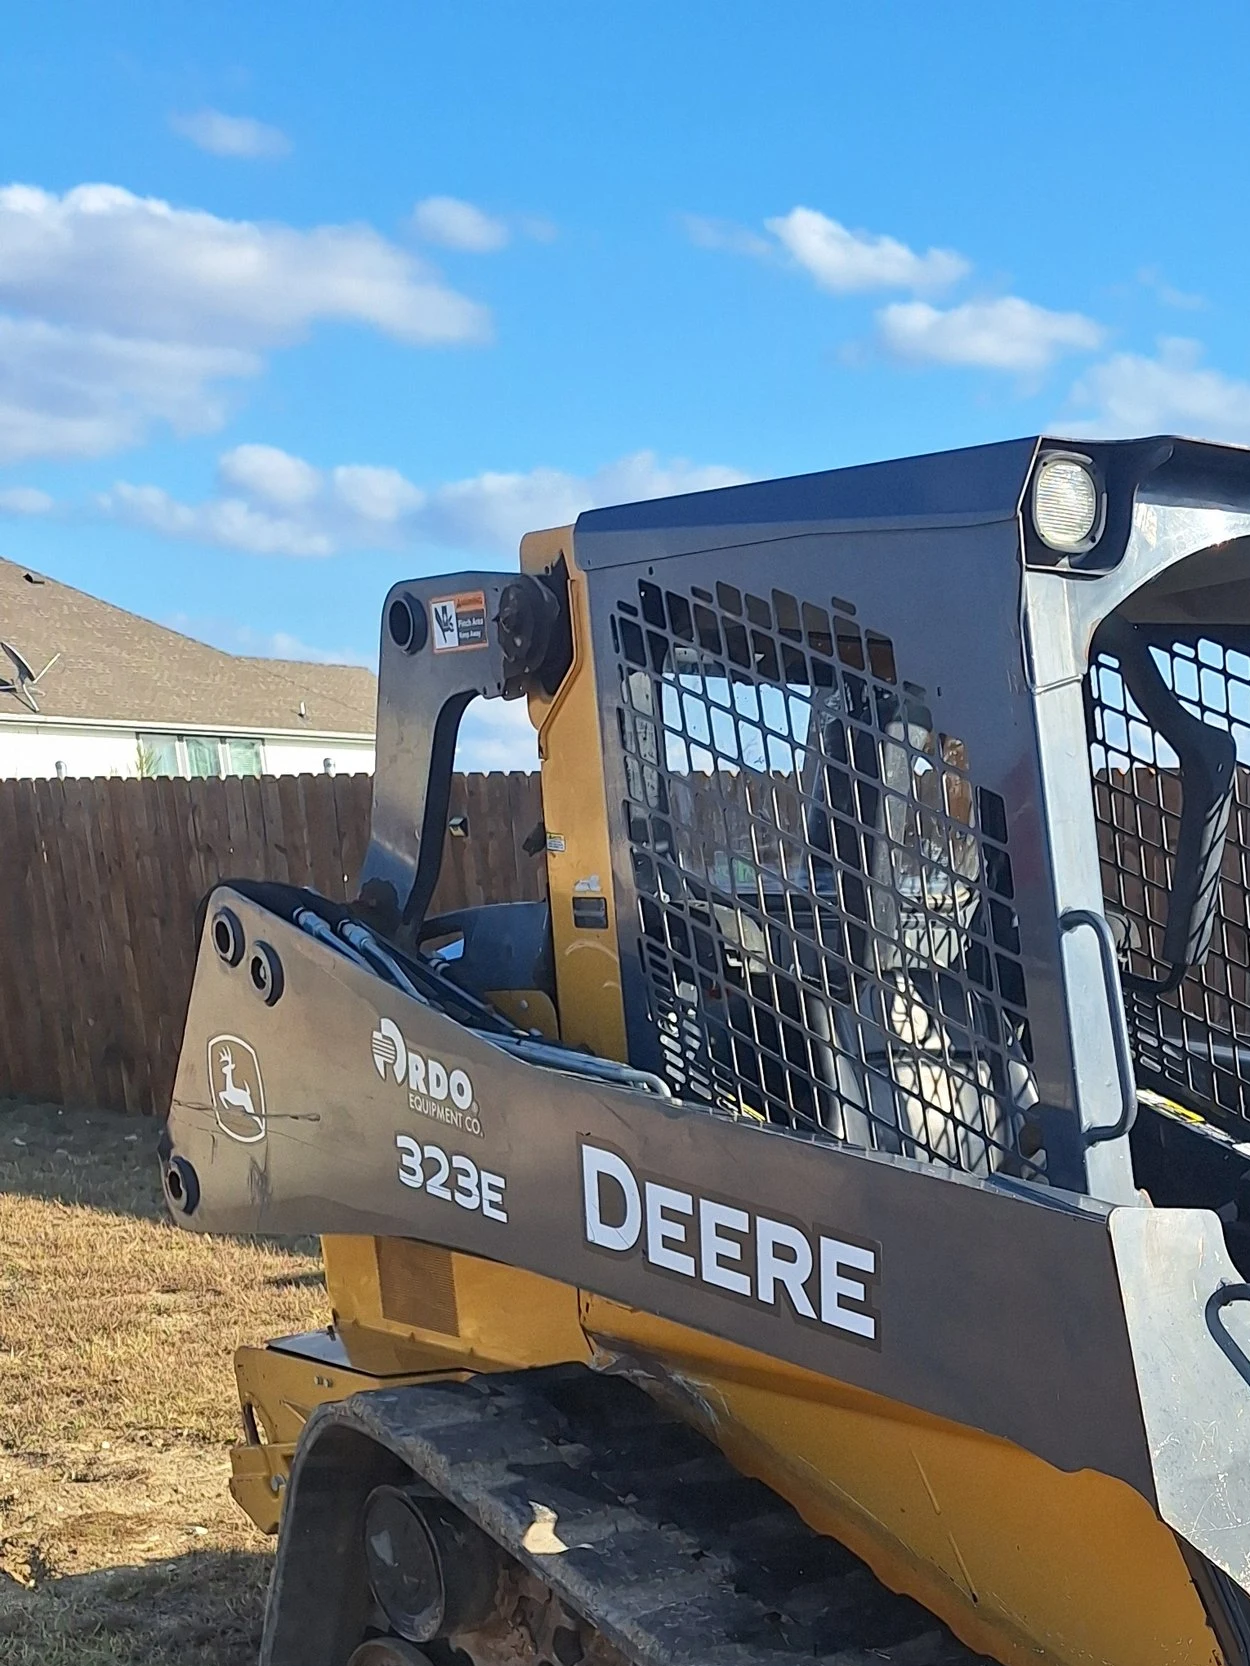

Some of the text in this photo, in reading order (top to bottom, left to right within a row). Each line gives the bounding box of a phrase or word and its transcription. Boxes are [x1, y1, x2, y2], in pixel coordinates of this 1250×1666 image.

[409, 1093, 484, 1137] EQUIPMENT CO.
[396, 1135, 508, 1223] 323E
[582, 1143, 876, 1340] DEERE
